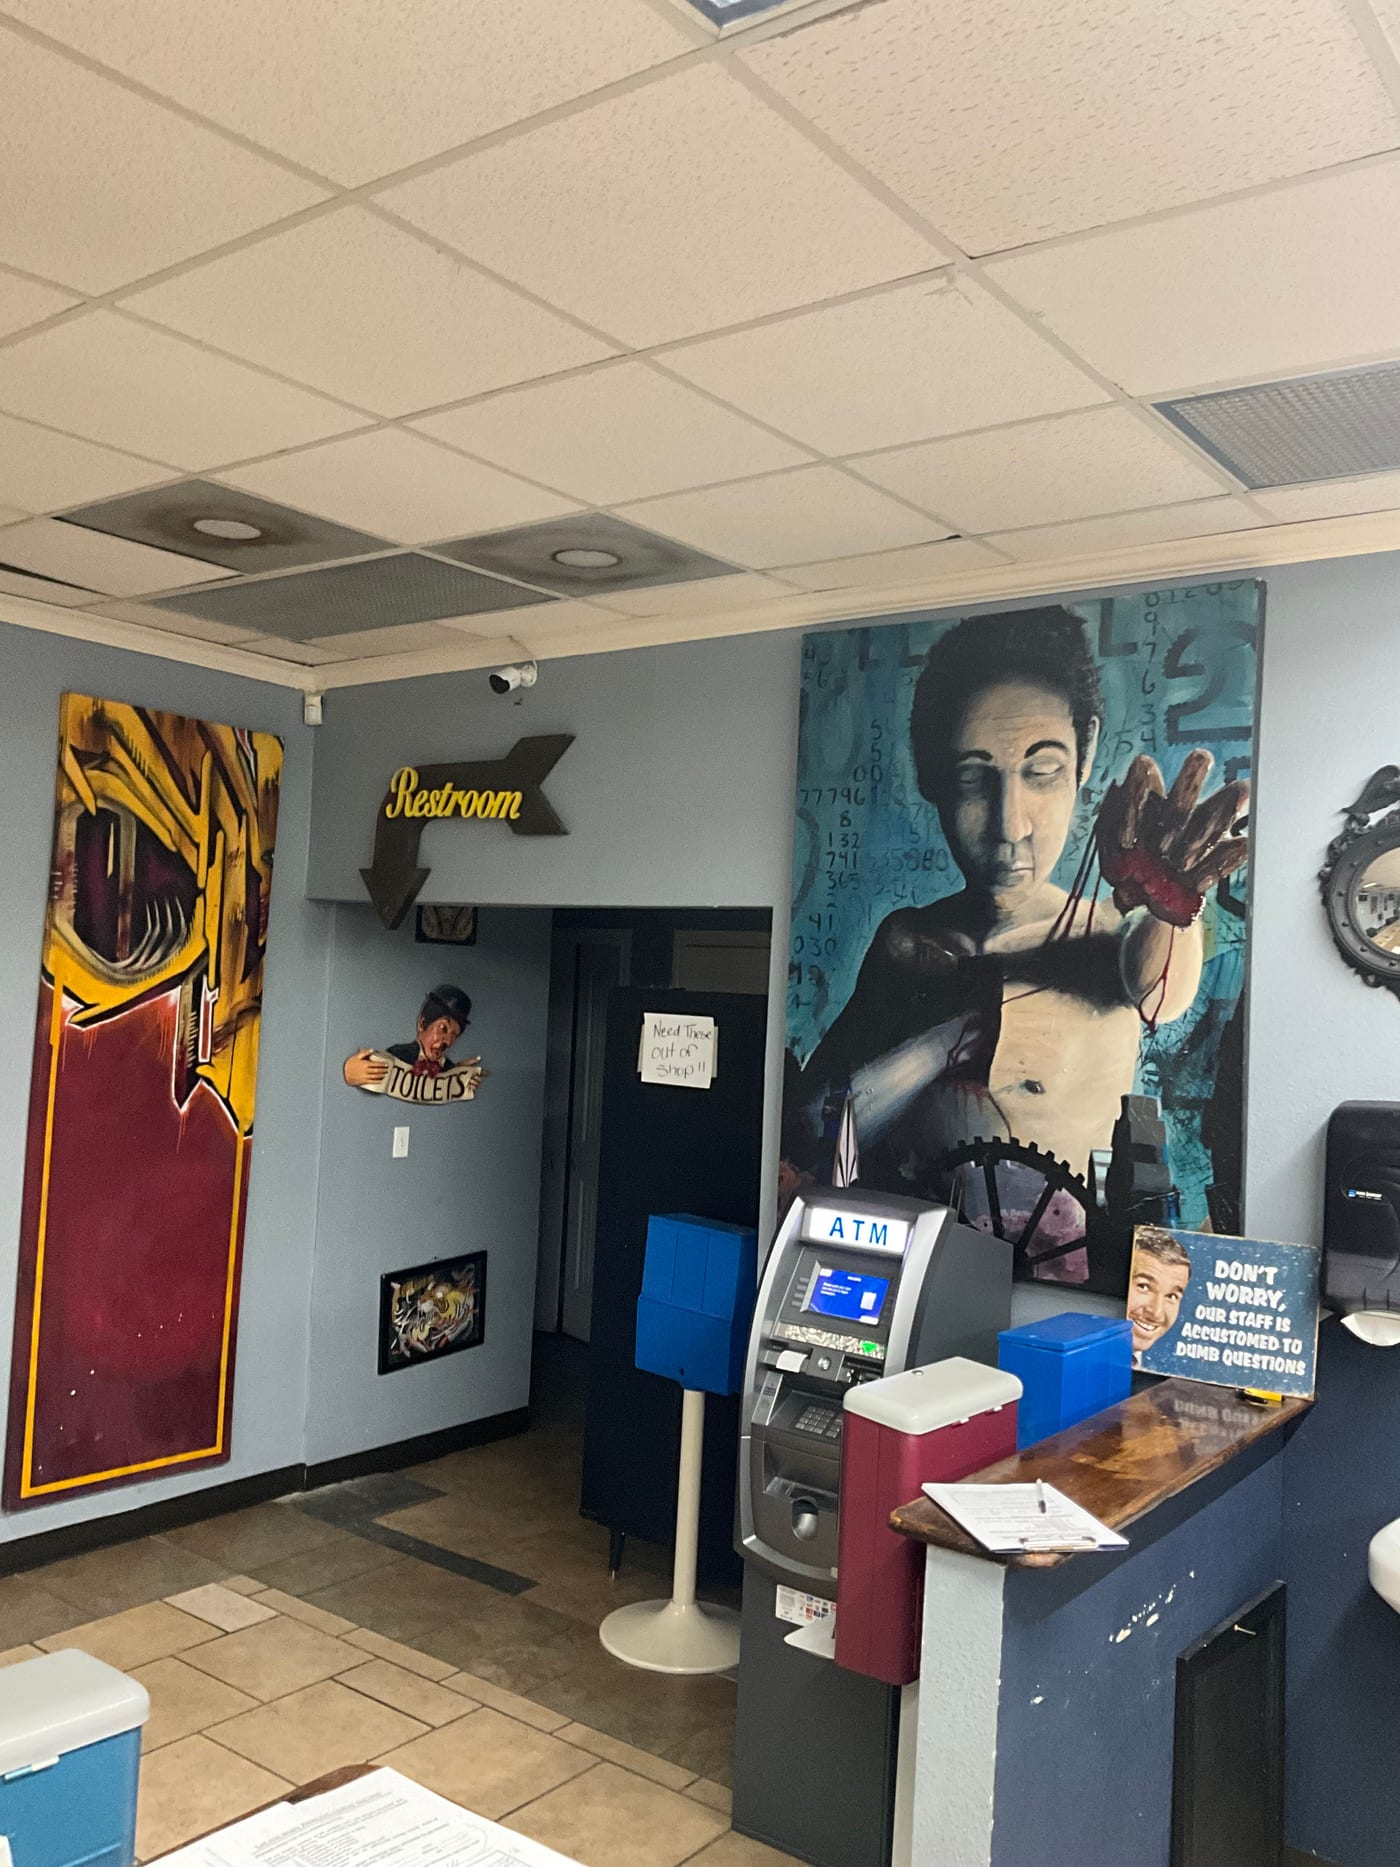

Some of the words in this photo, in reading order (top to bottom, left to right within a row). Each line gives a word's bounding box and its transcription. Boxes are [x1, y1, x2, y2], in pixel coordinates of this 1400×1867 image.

[386, 766, 523, 820] Restroom
[653, 1020, 681, 1039] Need
[390, 1065, 468, 1101] TOILETS
[829, 1216, 888, 1247] ATM
[1214, 1260, 1278, 1286] DON'T
[1206, 1281, 1289, 1312] WORRY,
[1195, 1305, 1226, 1325] OUR
[1228, 1309, 1274, 1330] STAFF
[1275, 1316, 1291, 1332] IS
[1181, 1322, 1280, 1351] ACCUSTOMED
[1282, 1338, 1303, 1355] TO
[1175, 1341, 1220, 1362] DUMB
[1222, 1348, 1306, 1376] QUESTIONS
